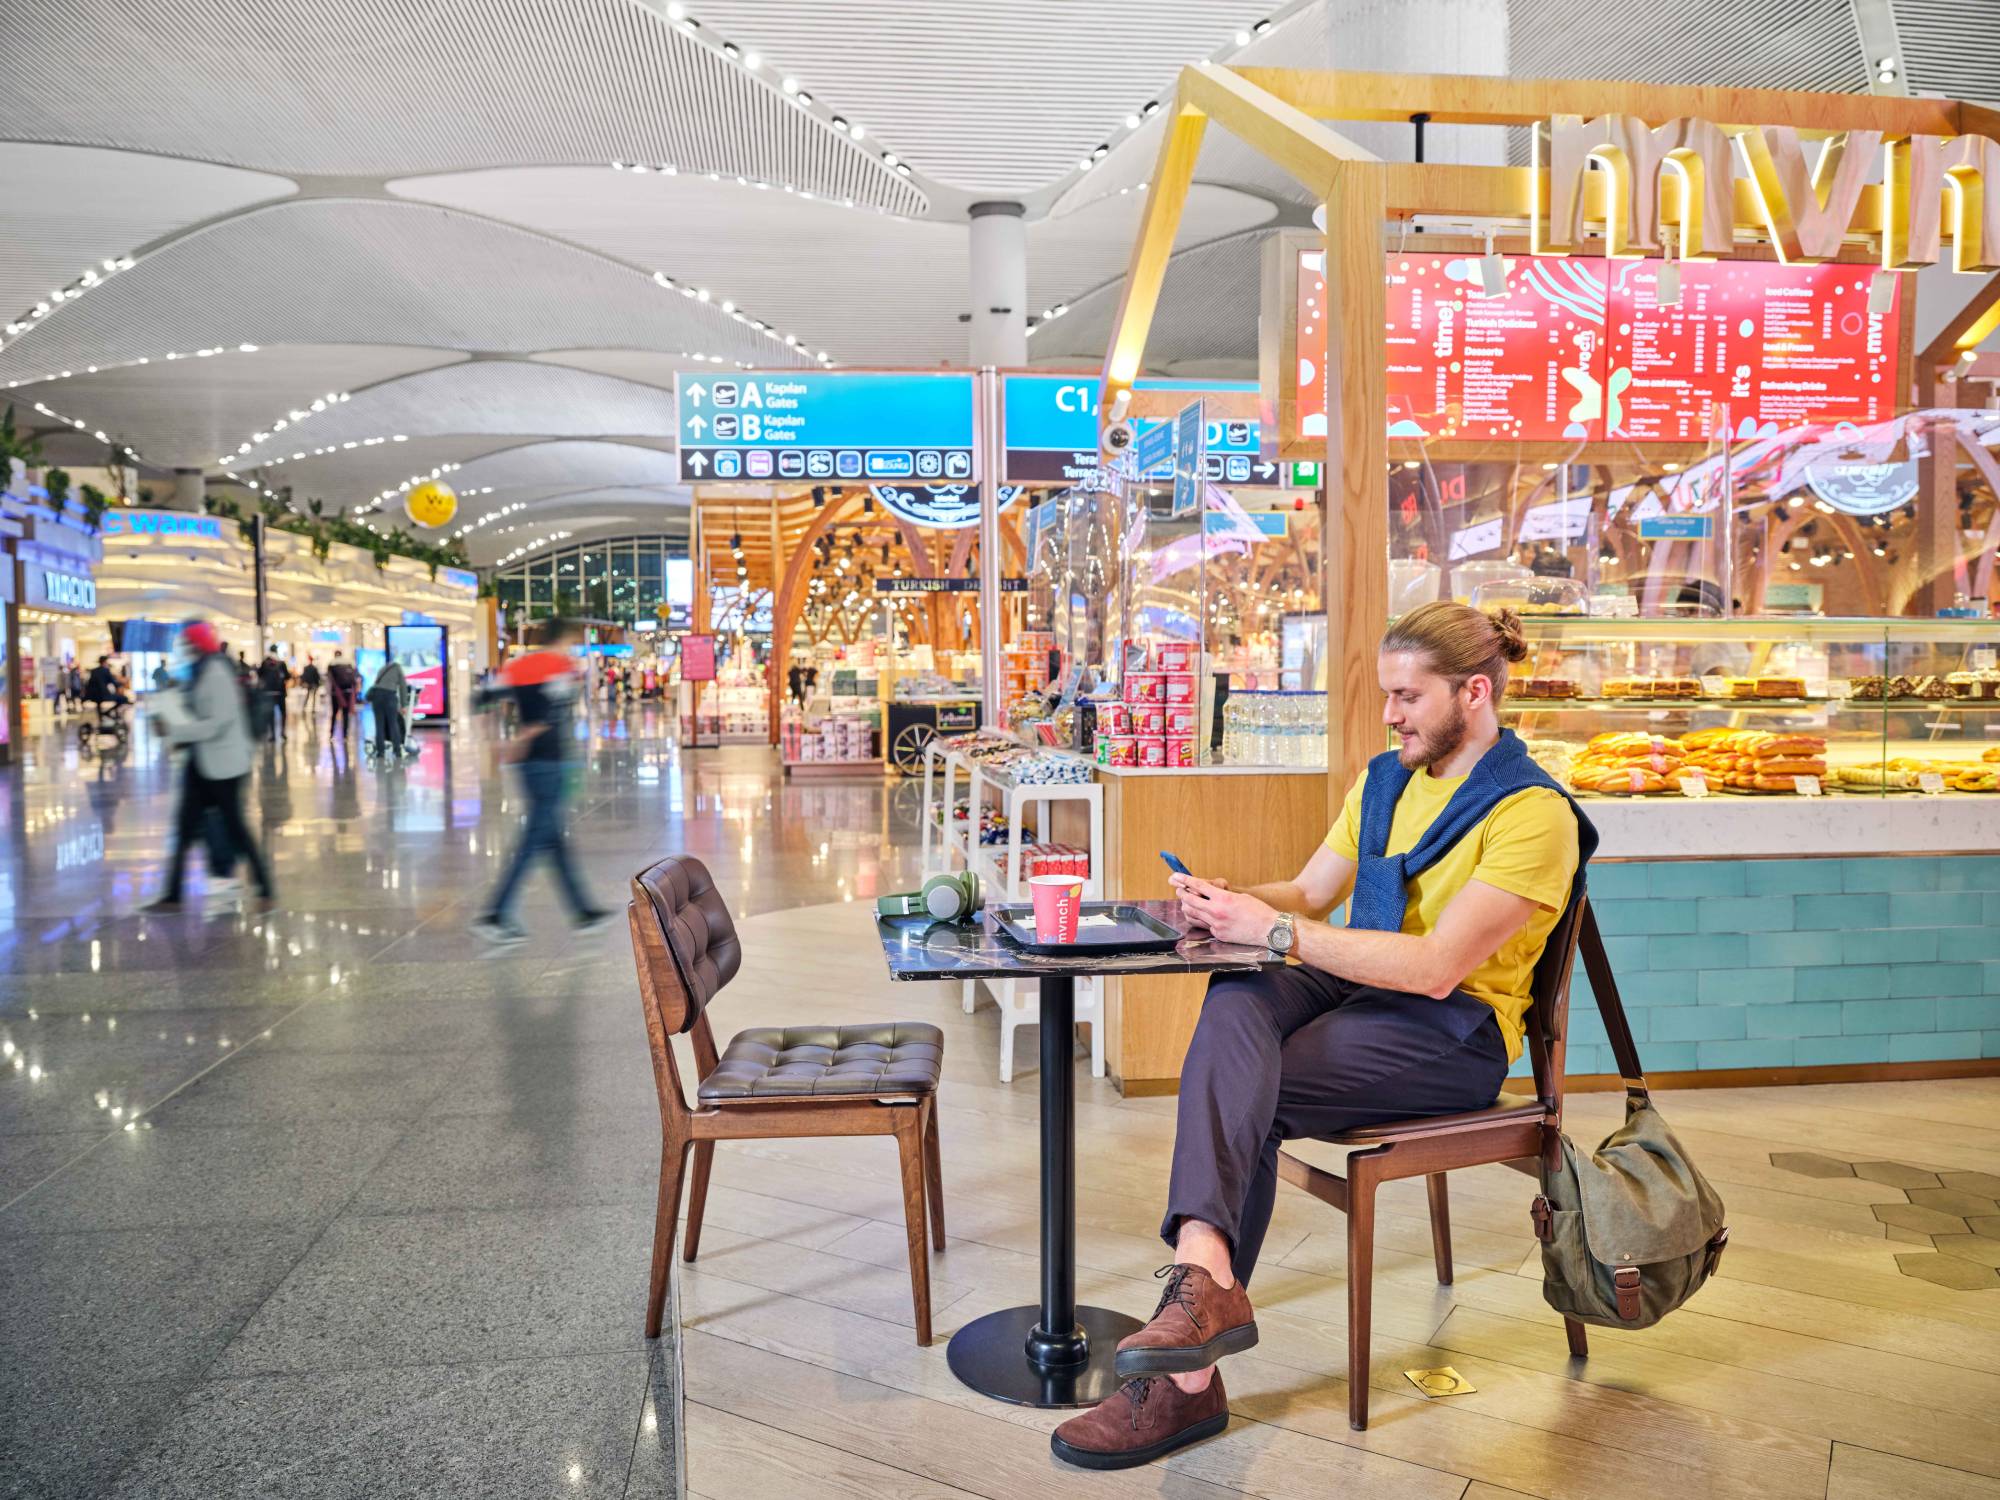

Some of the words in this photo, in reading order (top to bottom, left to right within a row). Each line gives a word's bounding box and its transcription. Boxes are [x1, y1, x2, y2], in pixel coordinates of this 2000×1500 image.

[1465, 318, 1497, 328] Turkish
[1464, 346, 1504, 357] Desserts
[740, 382, 763, 408] A
[765, 396, 798, 409] Gates
[742, 414, 761, 441] B
[764, 429, 796, 441] Gates
[892, 580, 950, 591] TURKISH
[963, 580, 1021, 591] DEHT
[1057, 899, 1069, 943] mvnch
